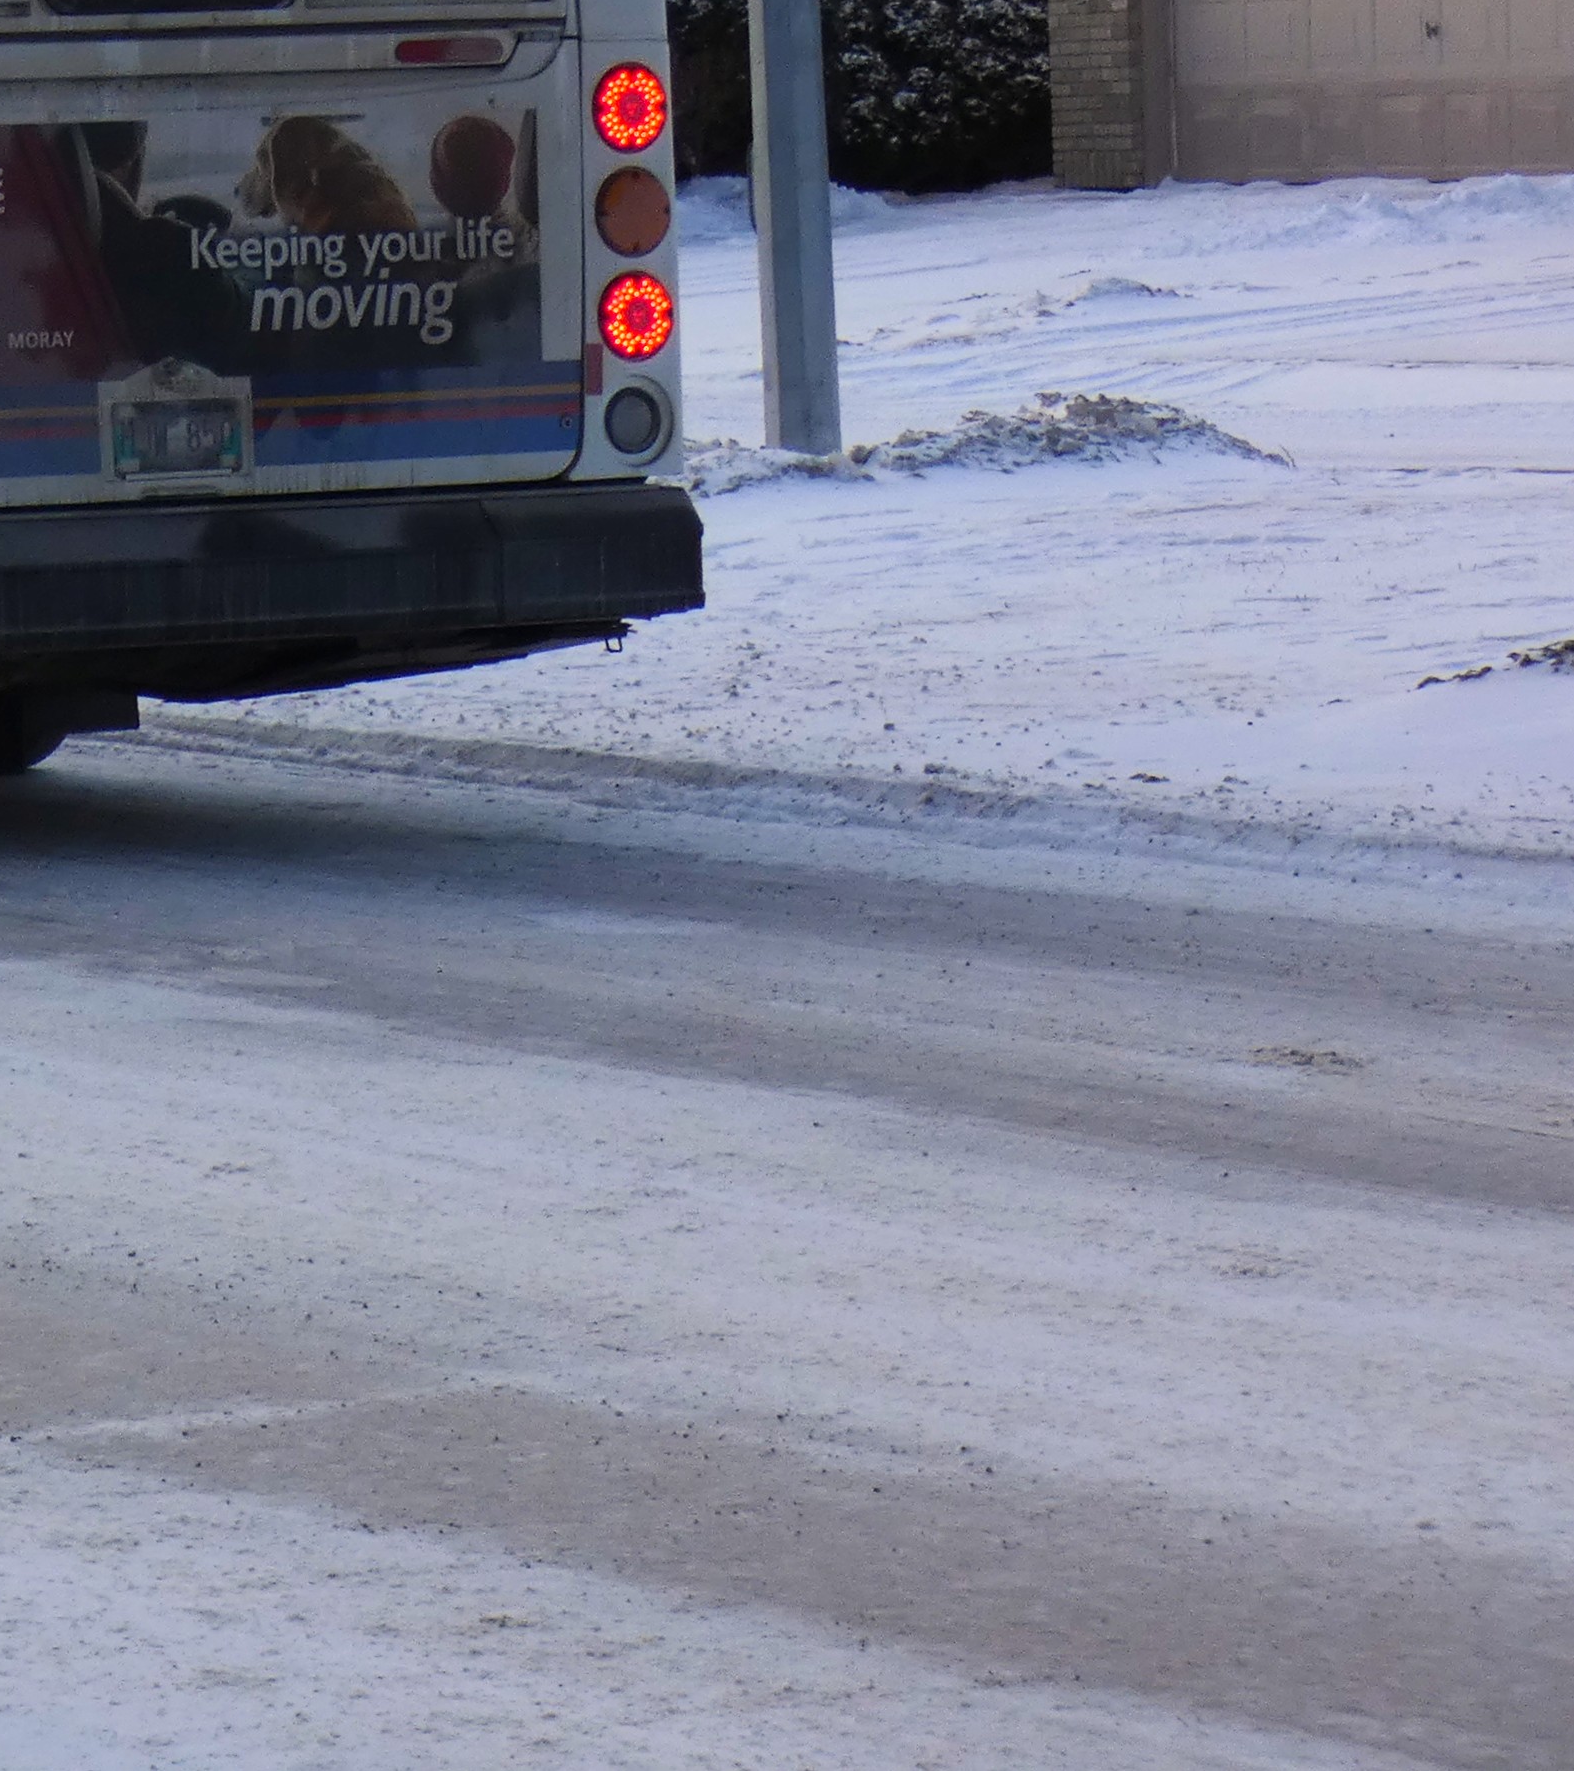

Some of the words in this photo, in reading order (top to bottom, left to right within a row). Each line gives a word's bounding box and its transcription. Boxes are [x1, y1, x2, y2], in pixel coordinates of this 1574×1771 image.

[190, 226, 348, 280] Keeping
[357, 231, 448, 278] your
[455, 216, 516, 260] life
[250, 266, 459, 346] moving
[8, 330, 75, 350] MORAY
